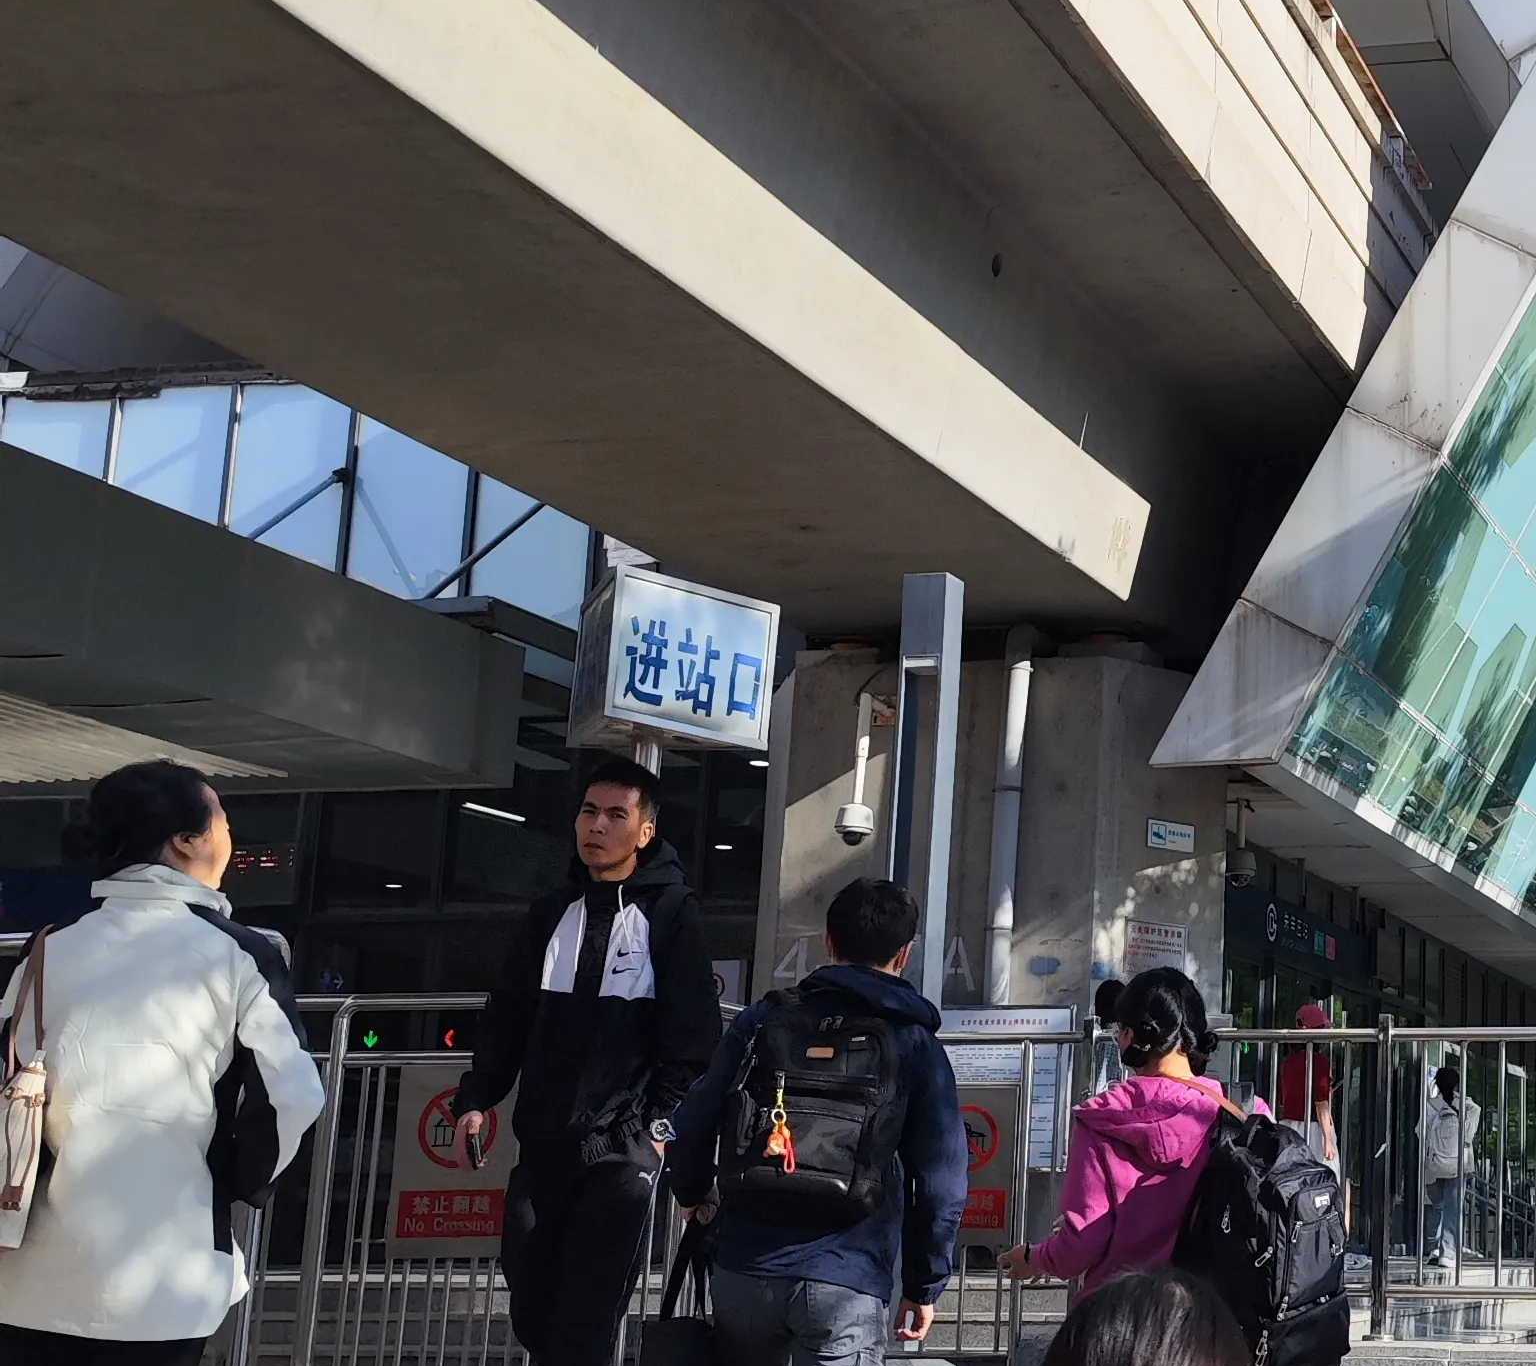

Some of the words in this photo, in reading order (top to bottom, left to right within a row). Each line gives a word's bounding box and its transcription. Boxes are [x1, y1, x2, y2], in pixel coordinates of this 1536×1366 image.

[622, 615, 763, 720] 进站口
[411, 1195, 492, 1215] 禁止翻越
[403, 1217, 425, 1233] No
[433, 1216, 495, 1235] Crossing
